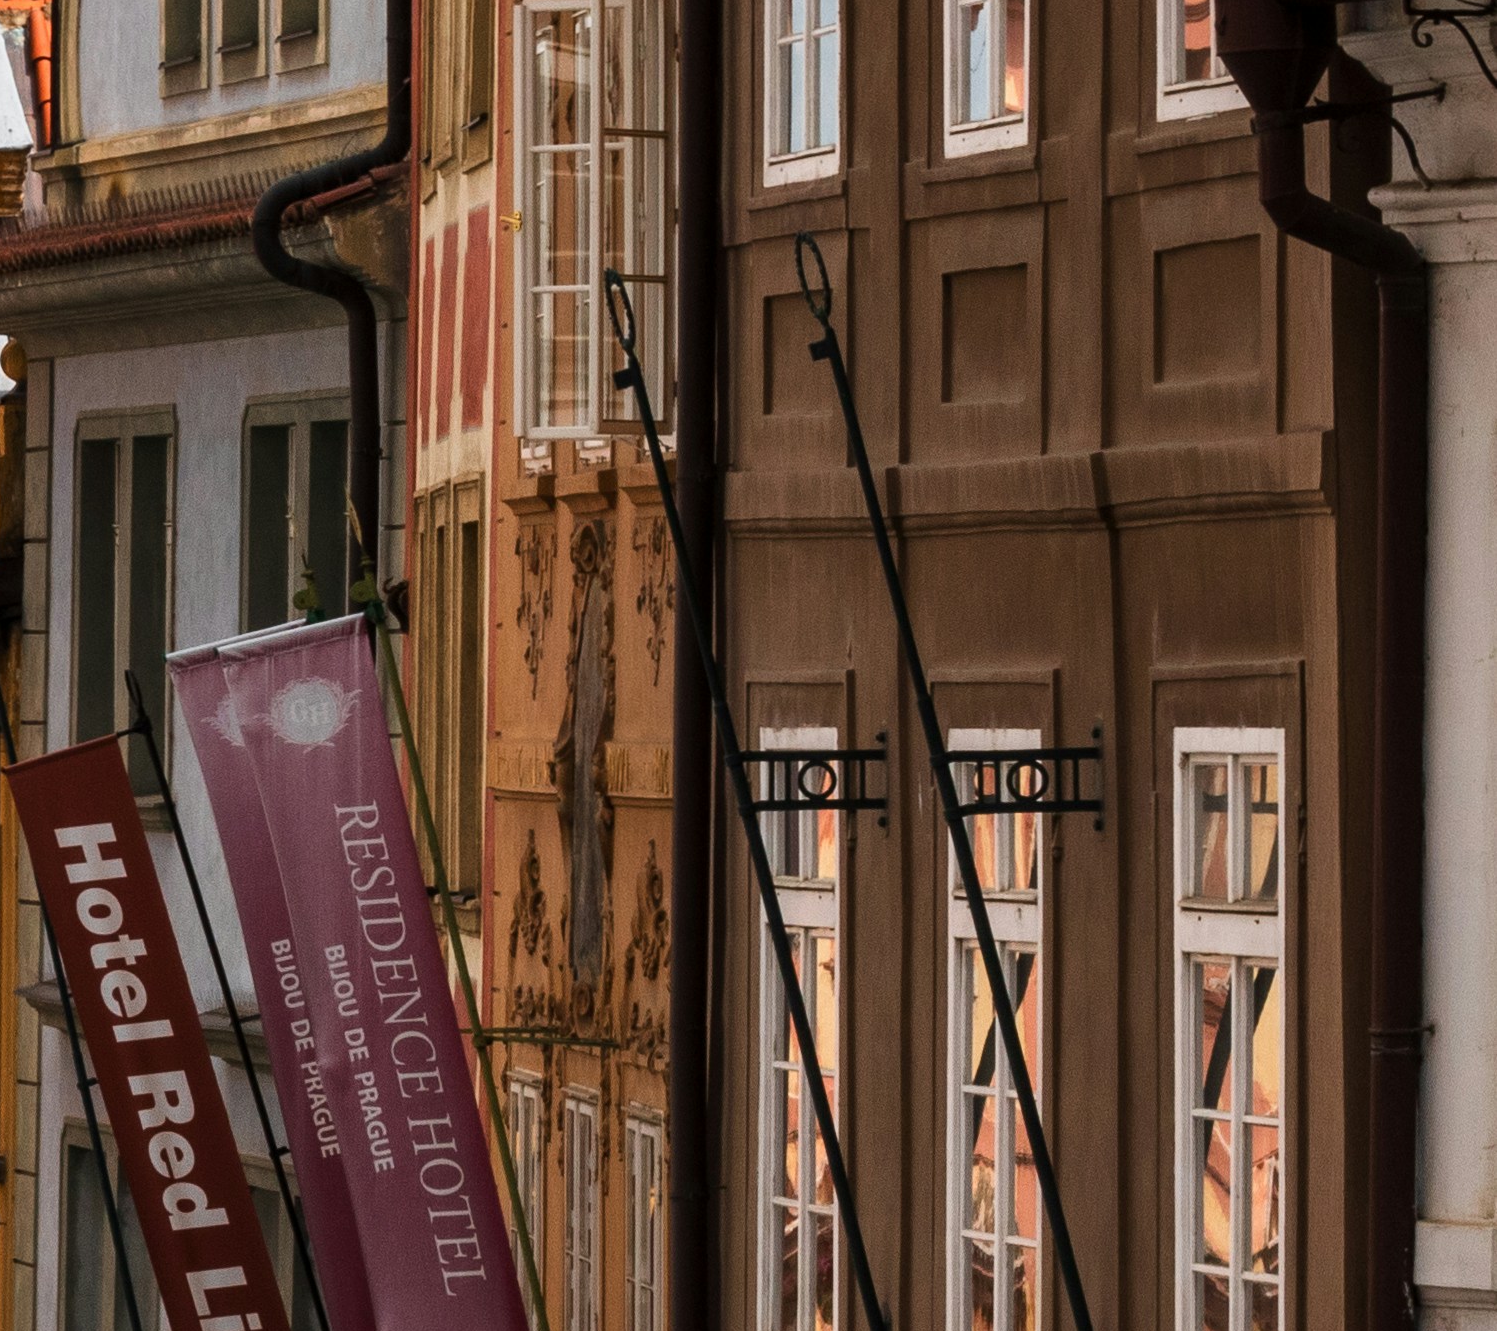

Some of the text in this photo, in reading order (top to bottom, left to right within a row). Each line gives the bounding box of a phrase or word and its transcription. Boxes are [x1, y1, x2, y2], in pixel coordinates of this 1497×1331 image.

[54, 821, 170, 1043] Hotel
[129, 1072, 230, 1233] Red
[269, 939, 342, 1159] BIJOU DE PRAGUE
[324, 943, 397, 1174] BIJOU DE PRAGUE
[333, 799, 487, 1298] RESIDENCE HOTEL
